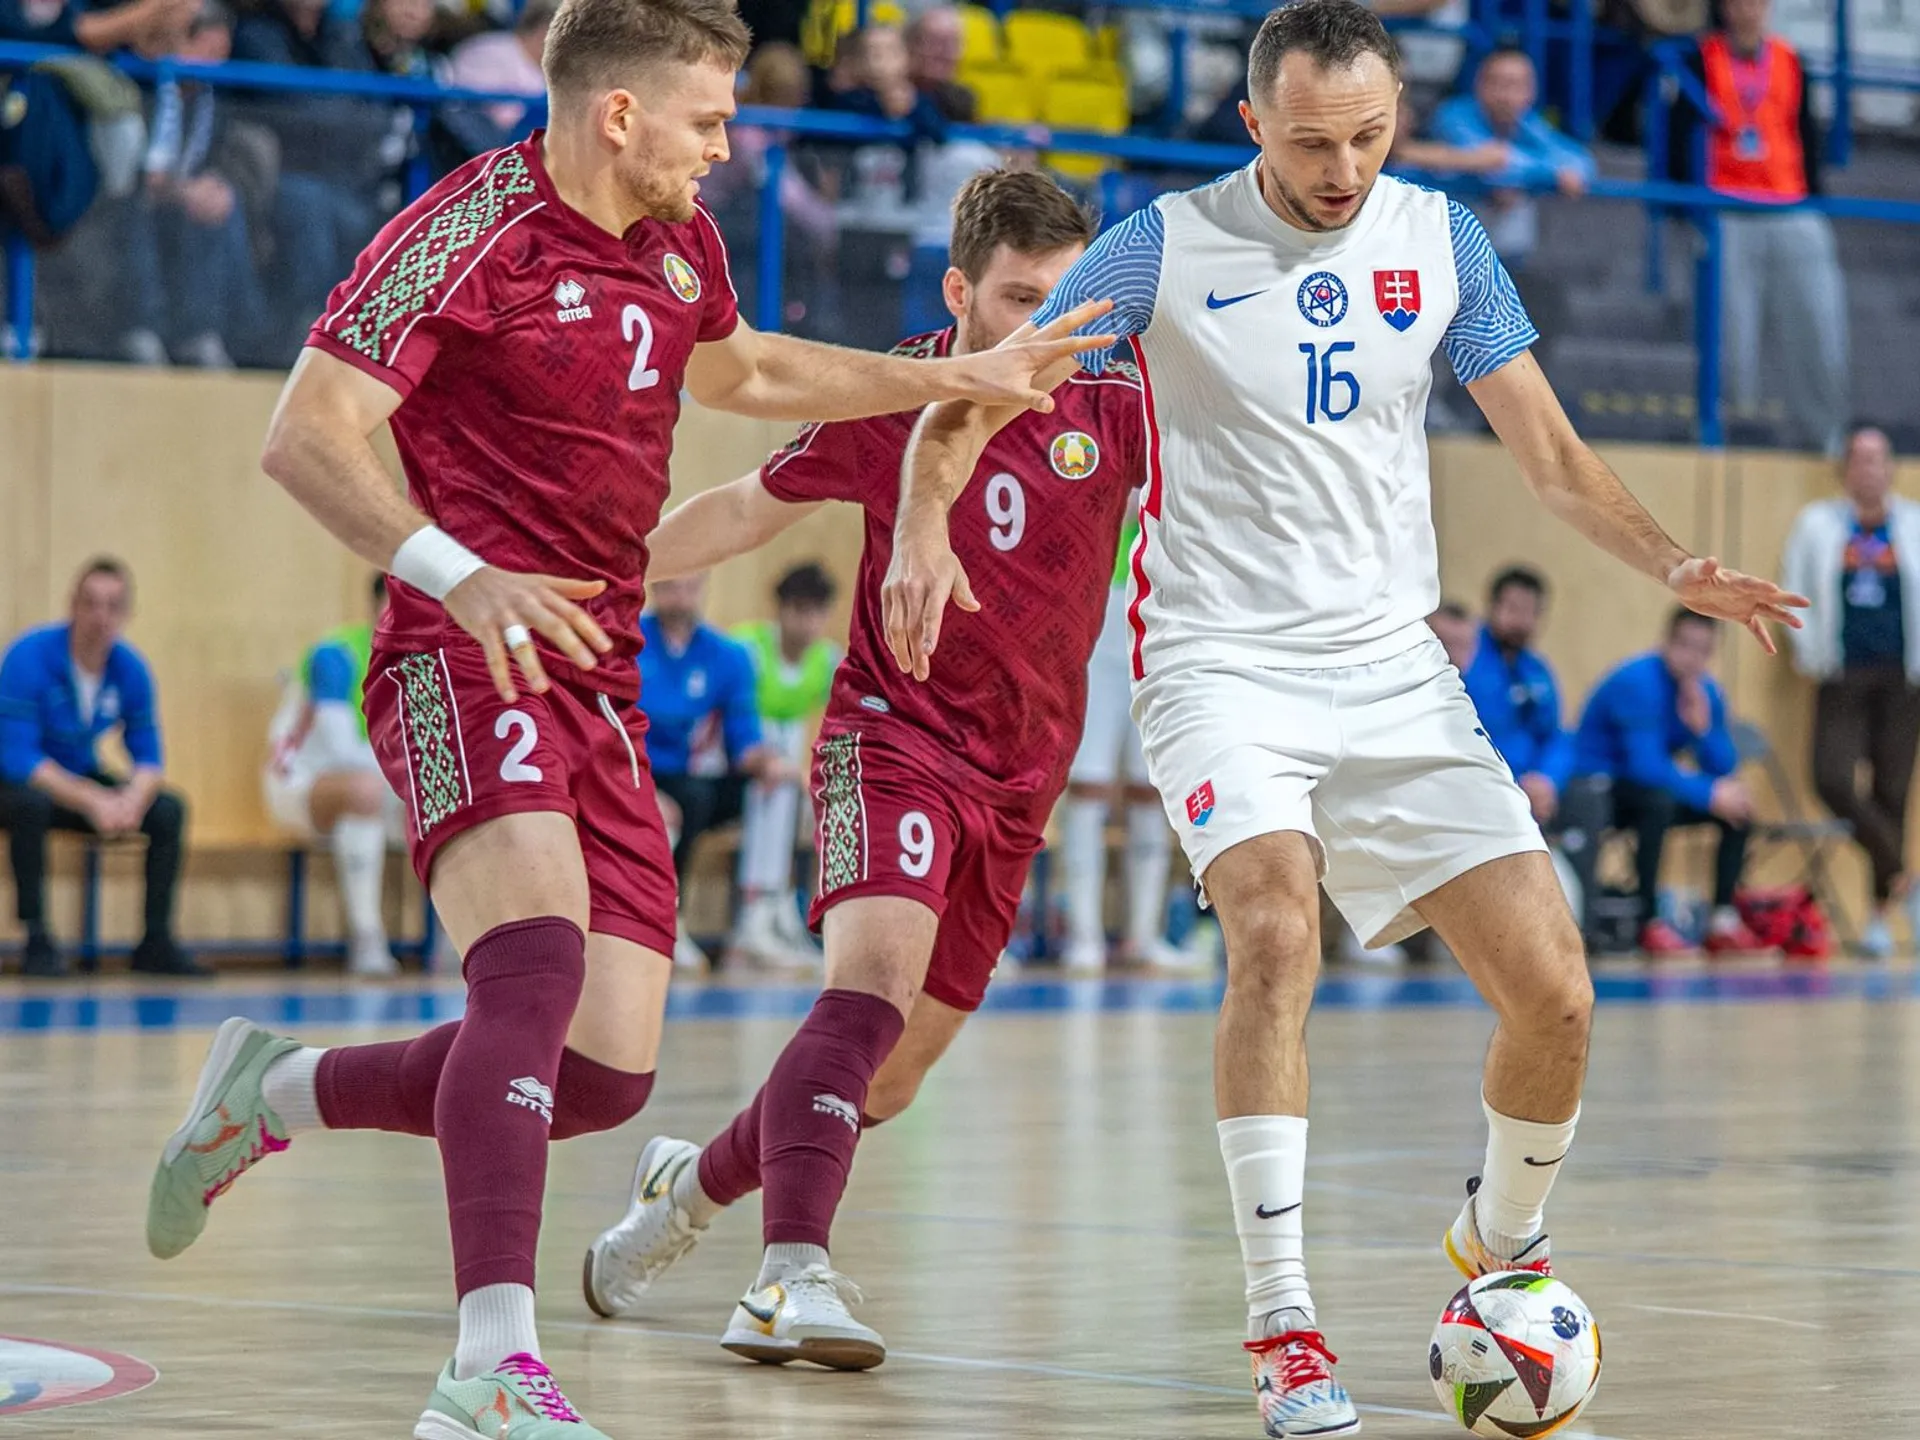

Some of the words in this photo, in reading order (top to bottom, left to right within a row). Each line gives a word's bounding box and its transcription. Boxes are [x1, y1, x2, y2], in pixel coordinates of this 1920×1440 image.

[557, 305, 592, 323] errea
[621, 304, 660, 391] 2
[1298, 341, 1361, 424] 16
[985, 472, 1026, 551] 9
[495, 709, 543, 782] 2
[899, 811, 935, 878] 9
